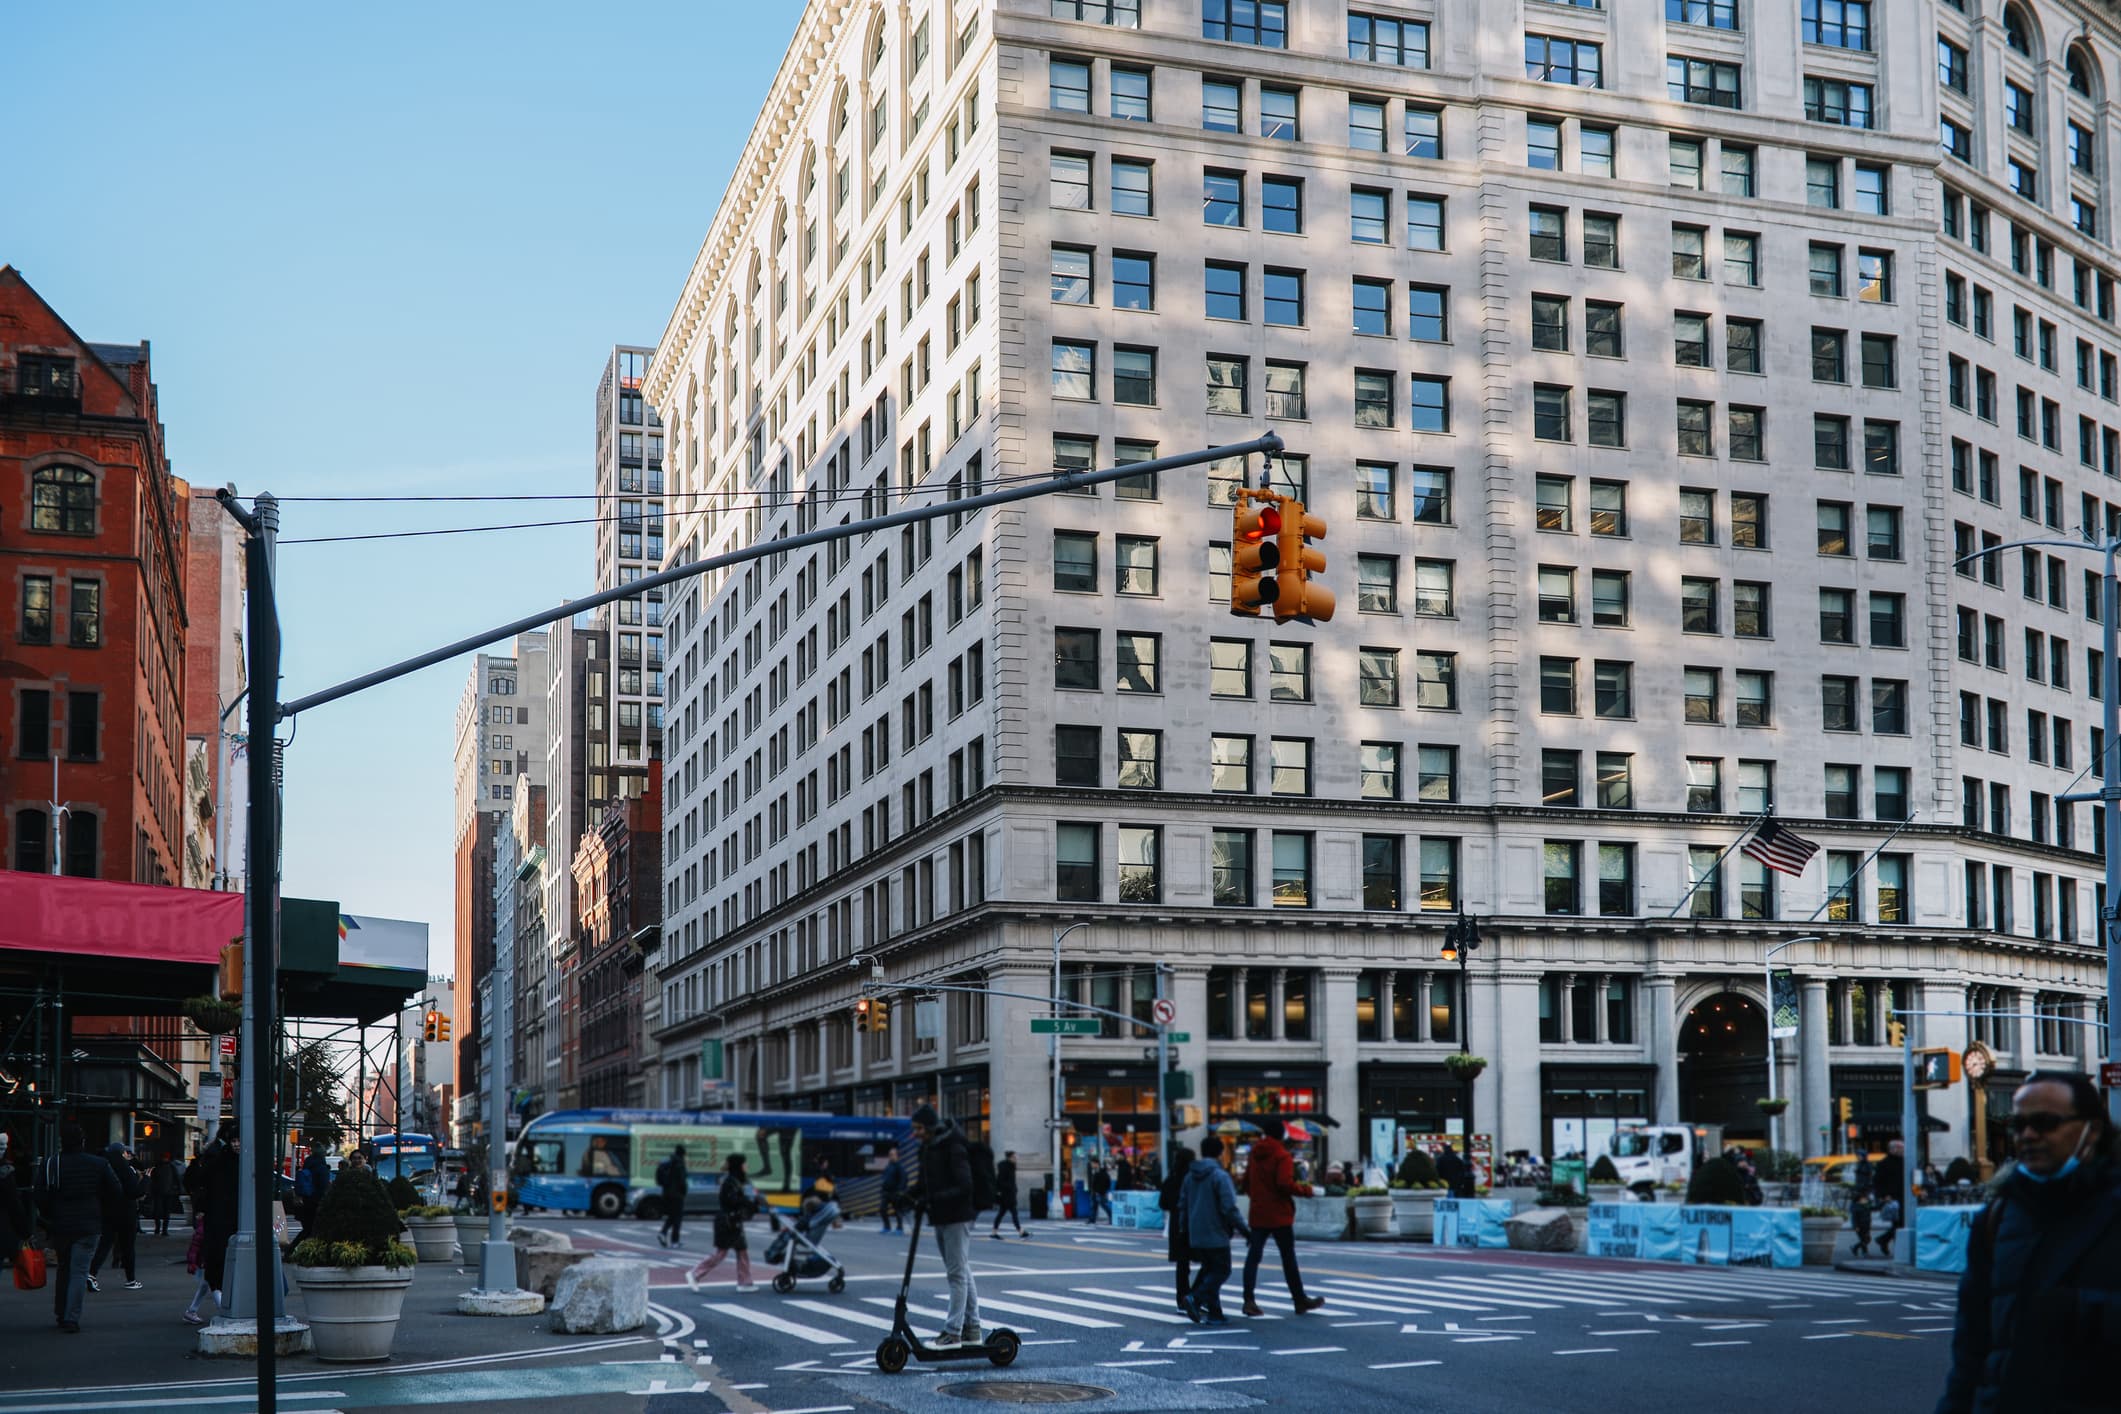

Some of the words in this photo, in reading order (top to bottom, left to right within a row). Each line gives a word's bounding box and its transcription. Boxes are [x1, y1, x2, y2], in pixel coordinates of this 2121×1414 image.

[1054, 1023, 1060, 1032] 5
[1064, 1023, 1076, 1032] Av
[1681, 1208, 1732, 1225] FLATIRON
